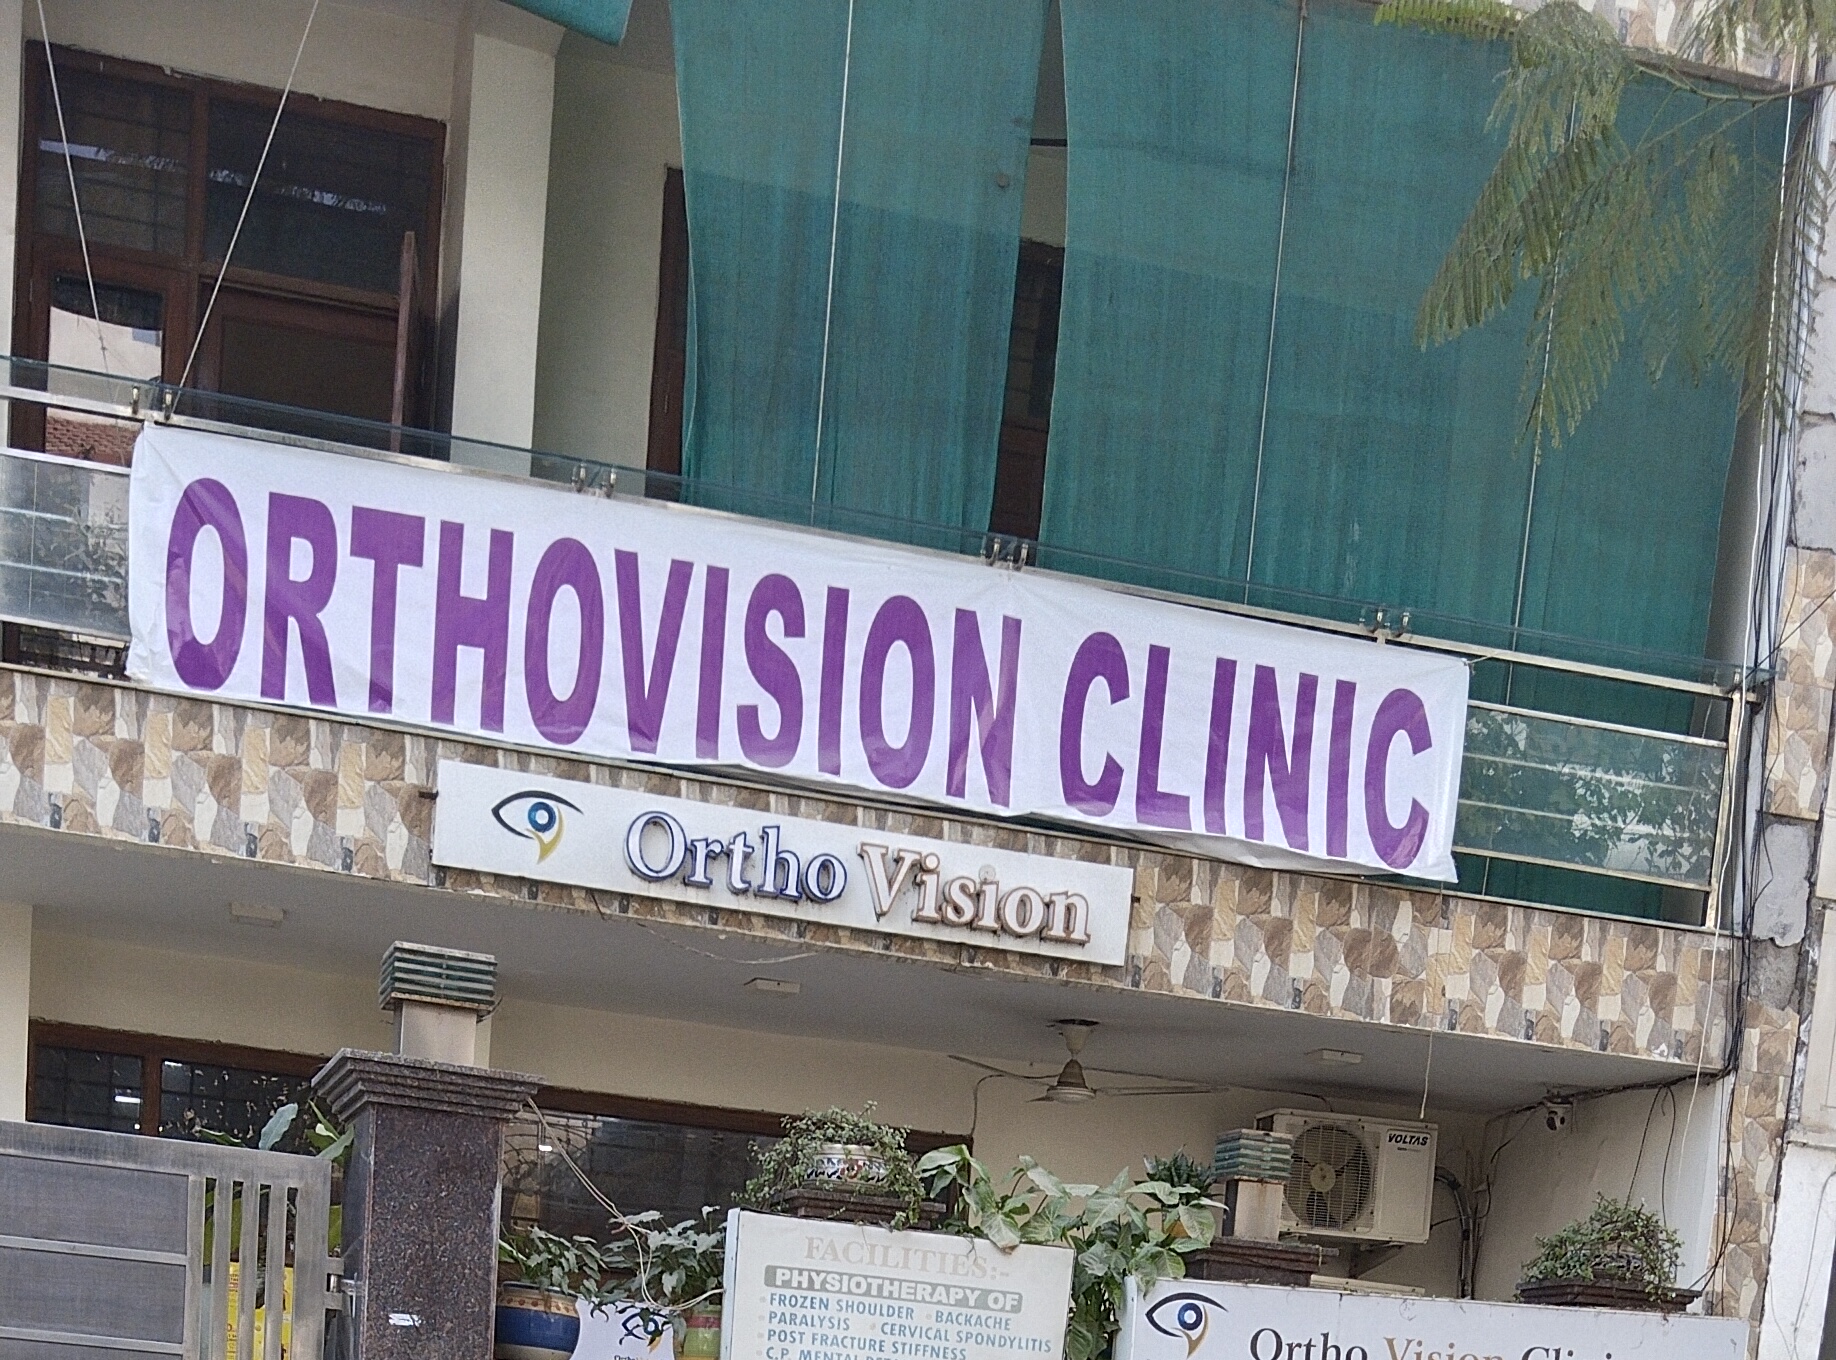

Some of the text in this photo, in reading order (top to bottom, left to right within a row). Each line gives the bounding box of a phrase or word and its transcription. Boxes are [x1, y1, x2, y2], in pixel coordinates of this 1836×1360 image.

[165, 476, 1432, 870] ORTHOVISION CLINIC
[624, 810, 1091, 945] Ortho Vision
[1387, 1133, 1429, 1146] VOLTAS
[769, 1292, 1012, 1331] FROZEN SHOULDER BACKACHE
[775, 1268, 1020, 1312] PHYSIOTHERAPY OF
[767, 1329, 967, 1360] POST FRACTURE STIFFNESS
[768, 1310, 1052, 1354] PARALYSIS CERVICAL SPONDYLITIS
